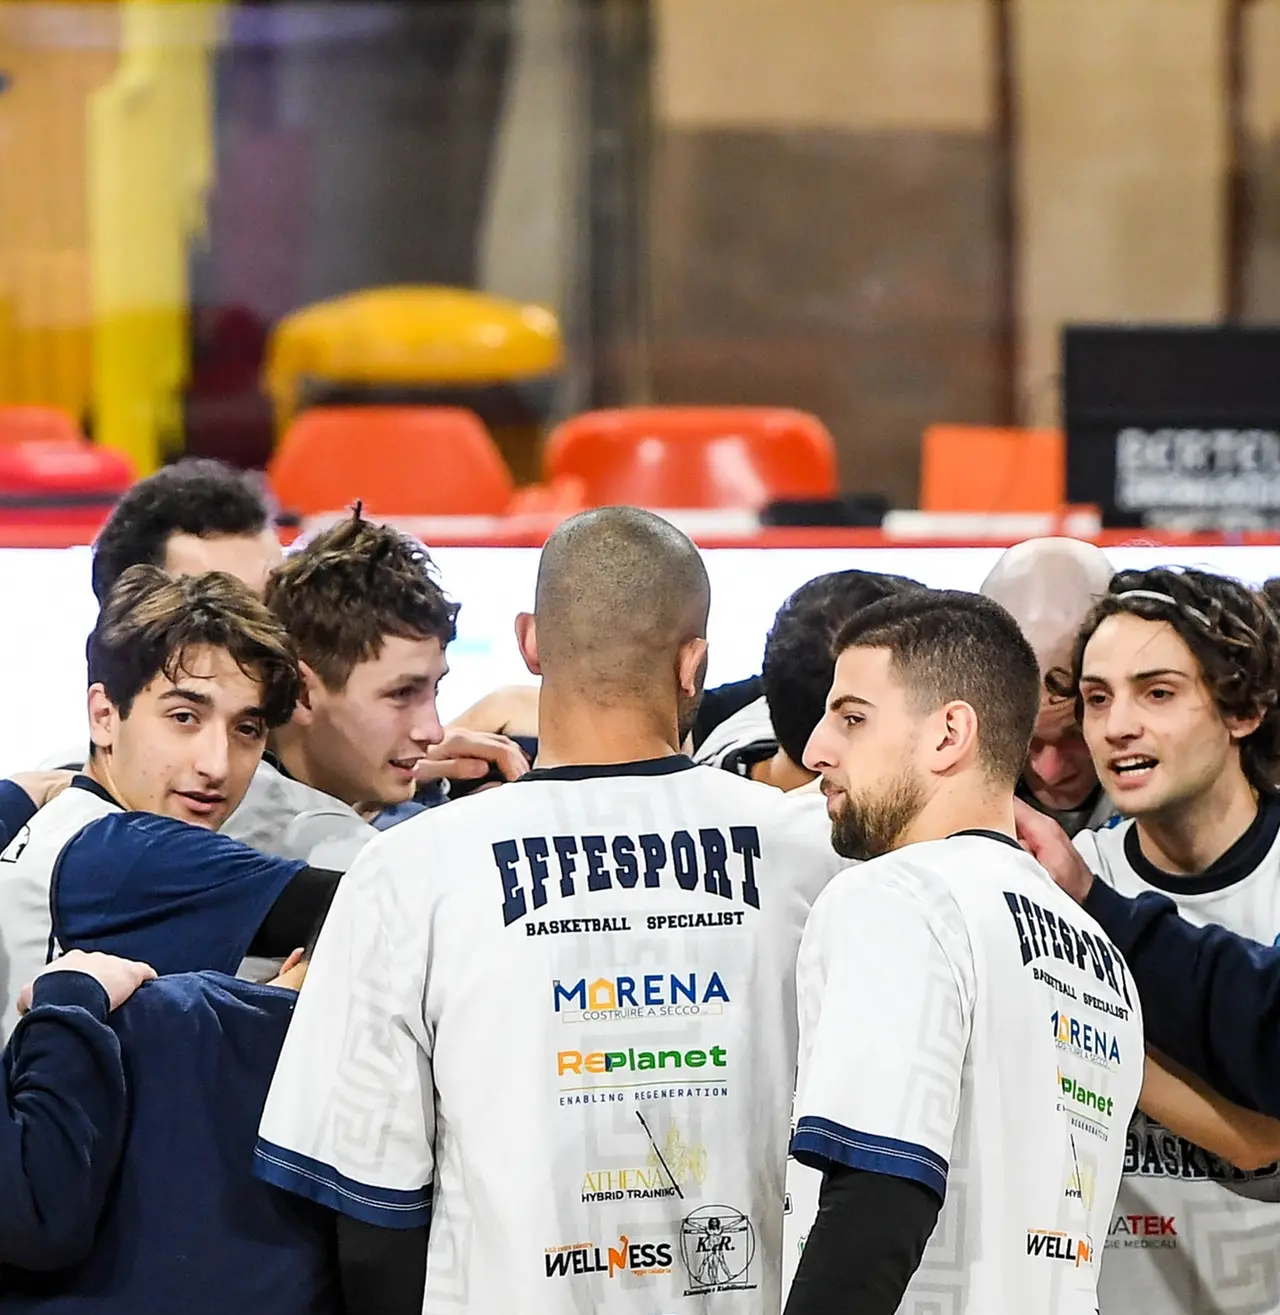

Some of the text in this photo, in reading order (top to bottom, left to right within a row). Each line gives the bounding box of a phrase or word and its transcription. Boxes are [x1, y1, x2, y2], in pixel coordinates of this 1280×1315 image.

[491, 825, 763, 927] EFFESPORT
[525, 911, 745, 936] BASKETBALL SPECIALIST
[1002, 890, 1133, 1012] EFFESPORT
[552, 971, 731, 1012] MORENA
[582, 1007, 644, 1021] COSTRUIRE
[647, 1007, 656, 1016] A
[559, 1088, 728, 1106] ENABLING REGENERATION
[581, 1187, 675, 1203] HYBRID TRAINING
[545, 1235, 673, 1278] WELLNESS
[1027, 1233, 1090, 1268] WELLN
